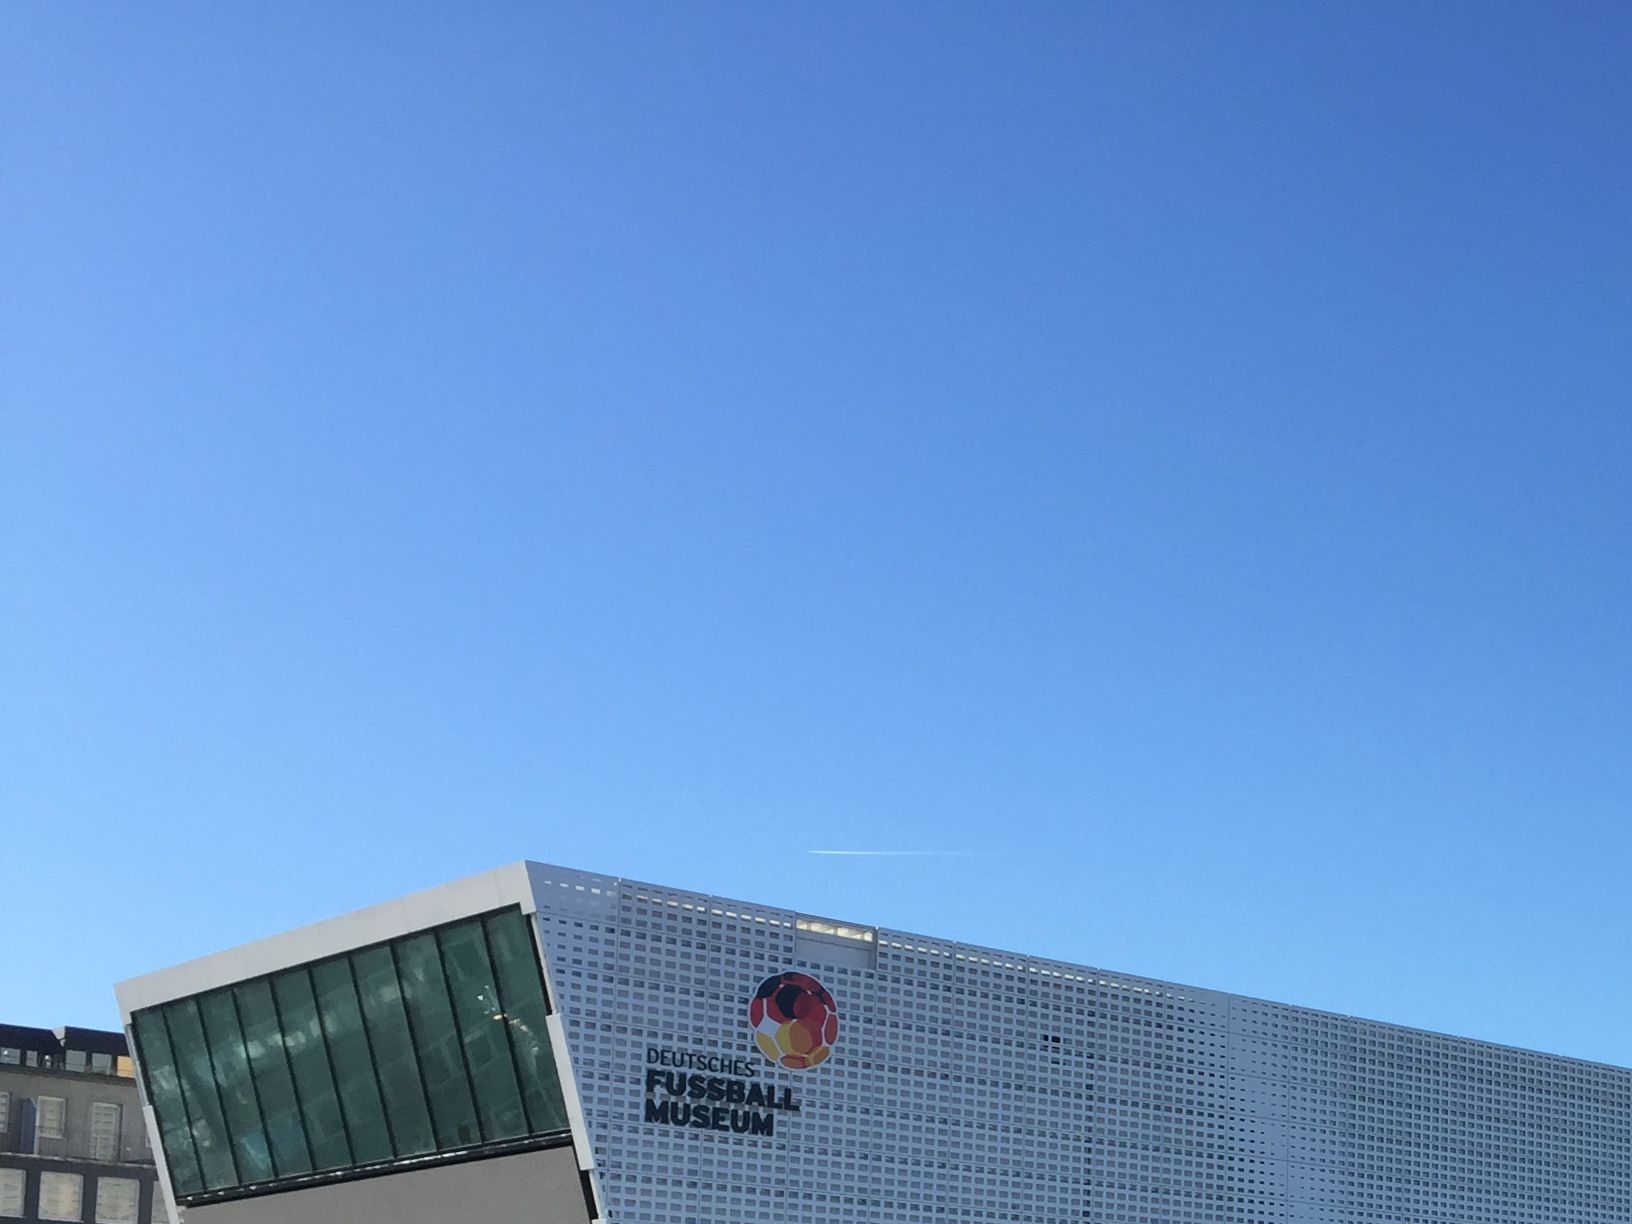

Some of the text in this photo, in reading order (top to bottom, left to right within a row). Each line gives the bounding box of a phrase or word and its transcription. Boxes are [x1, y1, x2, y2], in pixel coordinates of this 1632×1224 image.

[647, 1048, 756, 1077] DEUTSCHES
[646, 1069, 800, 1112] FUSSBALL
[645, 1098, 774, 1137] MUSEUM
